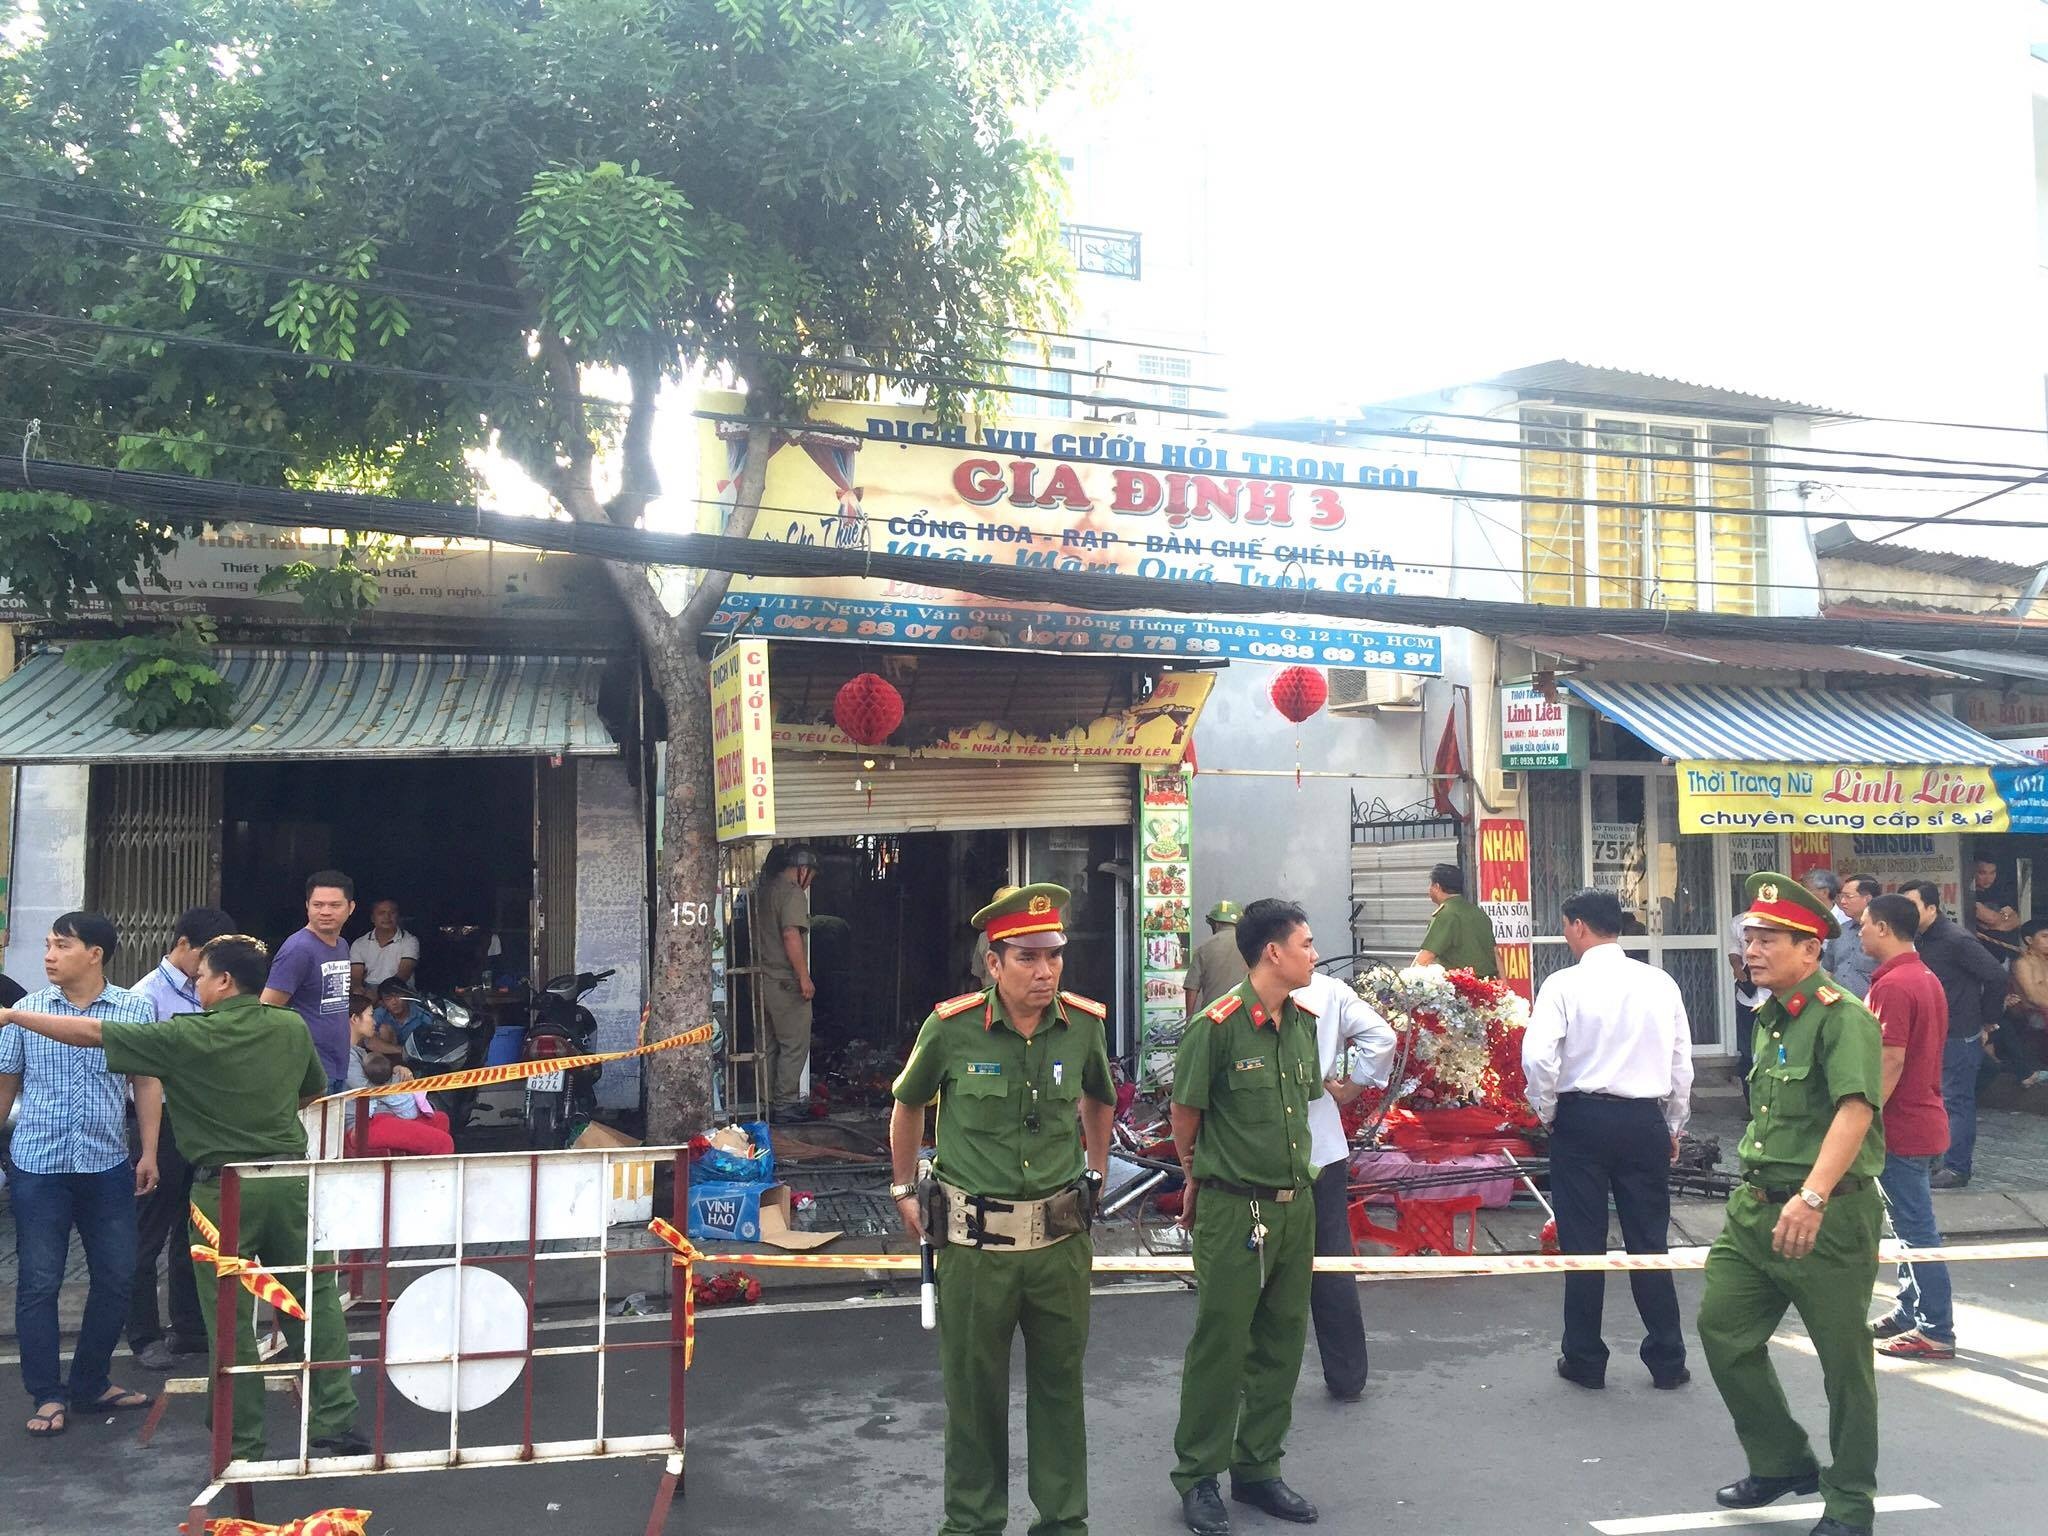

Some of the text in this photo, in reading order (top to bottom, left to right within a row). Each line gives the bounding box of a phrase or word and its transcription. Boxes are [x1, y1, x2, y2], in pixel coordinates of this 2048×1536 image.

[1161, 438, 1229, 472] HỎI
[952, 457, 1348, 532] GIA ĐỊNH 3
[887, 508, 967, 541] CỔNG
[976, 522, 1034, 545] HOA
[1061, 529, 1120, 552] RẠP
[1145, 531, 1201, 556] BÀN
[1210, 536, 1264, 561] GHẾ
[1273, 544, 1345, 568] CHÉN
[758, 597, 814, 611] 1/117
[821, 601, 908, 620] Nguyễn
[919, 606, 962, 621] Văn
[1128, 618, 1192, 637] Hưng
[1193, 621, 1261, 639] Thuận
[1309, 631, 1329, 642] 12
[1386, 635, 1435, 649] HCM
[773, 614, 849, 633] 0972
[904, 623, 944, 640] 07
[1101, 634, 1134, 650] 76
[1322, 645, 1356, 662] 69
[713, 653, 740, 690] DỊCH VỤ
[1507, 702, 1562, 723] Linh Liên
[972, 743, 1012, 756] NHẬN
[1016, 744, 1048, 757] TIỆC
[1687, 770, 1813, 798] Thời Trang Nữ
[1822, 766, 1985, 804] Linh Liên
[1700, 810, 1795, 828] chuyên
[1803, 813, 1865, 829] cung
[1872, 811, 1920, 829] cấp
[1927, 811, 1944, 826] sỉ
[1950, 812, 1969, 826] &
[1483, 822, 1525, 871] NHẬN
[1751, 837, 1774, 849] JEAN
[1853, 834, 1936, 856] SAMSUNG
[671, 901, 709, 927] 150
[1511, 902, 1529, 916] SỬA
[1516, 920, 1530, 938] ÁO
[531, 1080, 558, 1090] 0274
